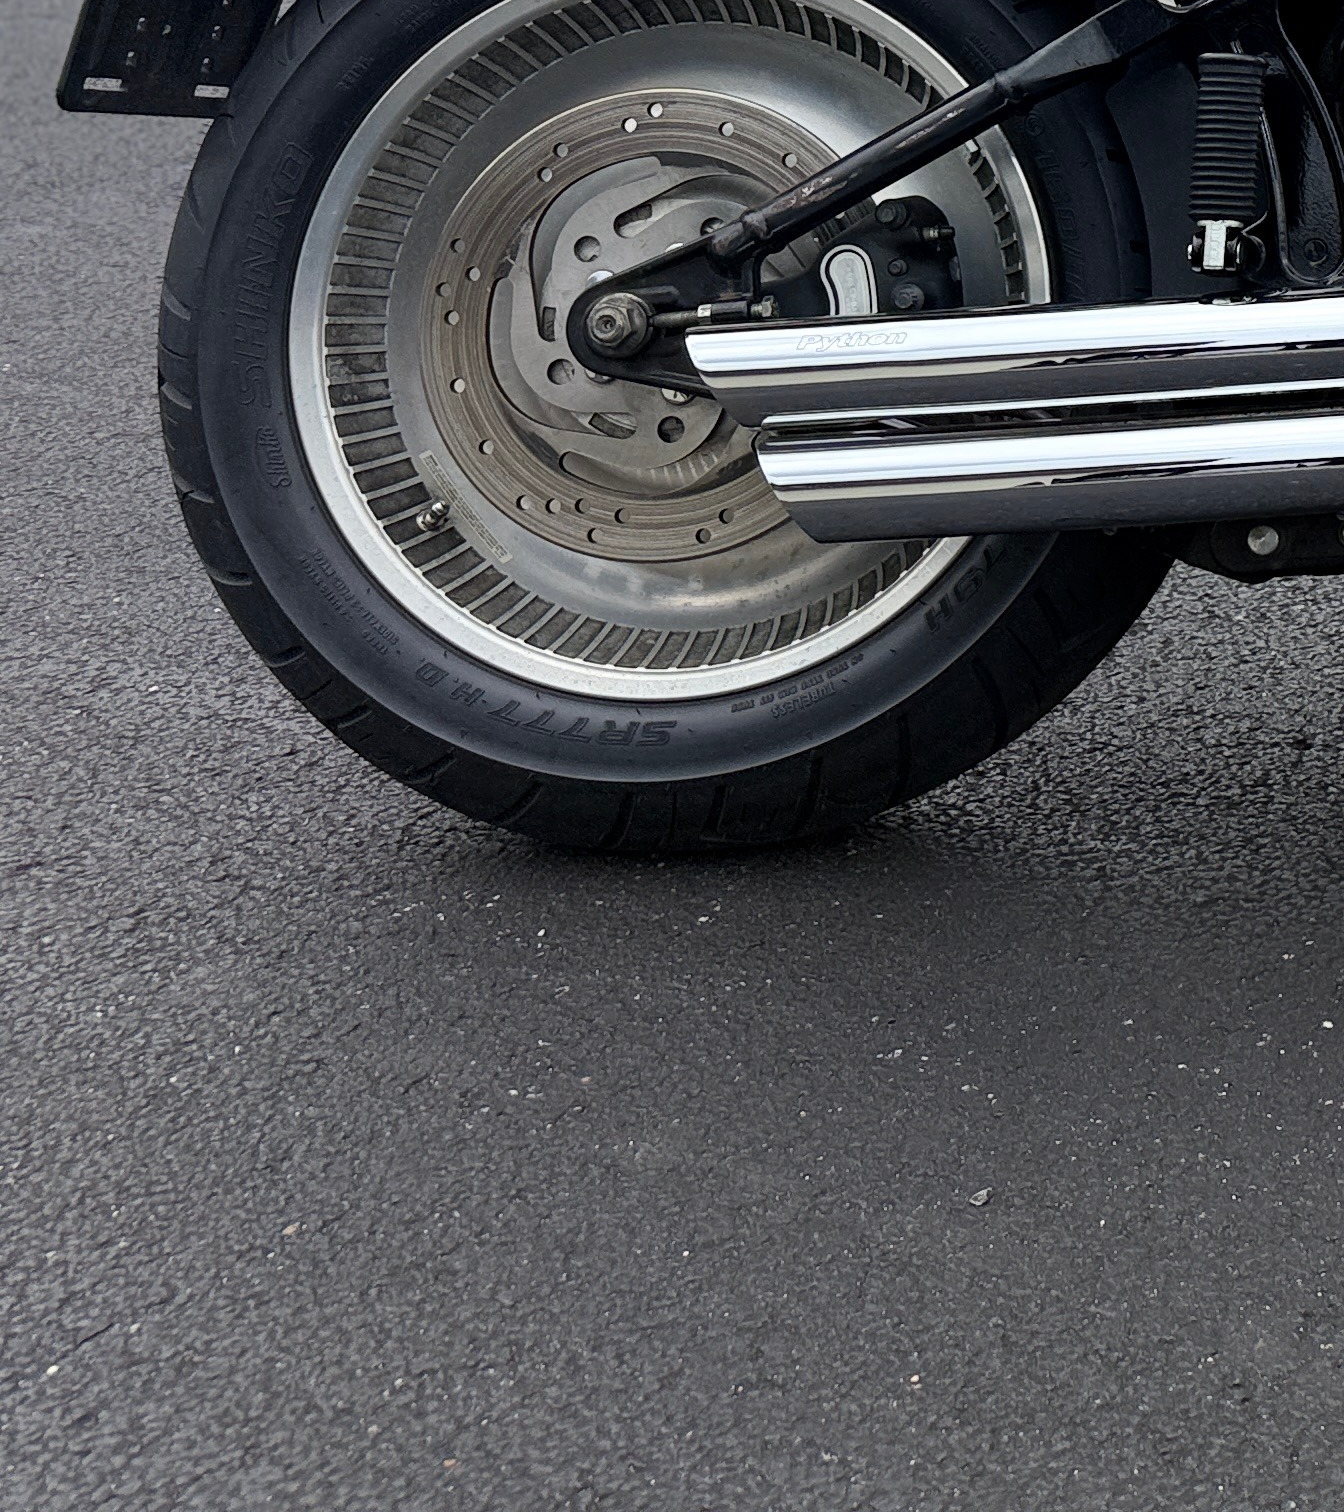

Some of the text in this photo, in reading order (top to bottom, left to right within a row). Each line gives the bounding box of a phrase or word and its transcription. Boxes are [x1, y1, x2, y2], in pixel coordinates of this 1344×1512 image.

[234, 142, 314, 412] SHINKO
[796, 330, 908, 352] Python
[485, 692, 676, 750] SR777
[769, 681, 838, 719] TUBELESS
